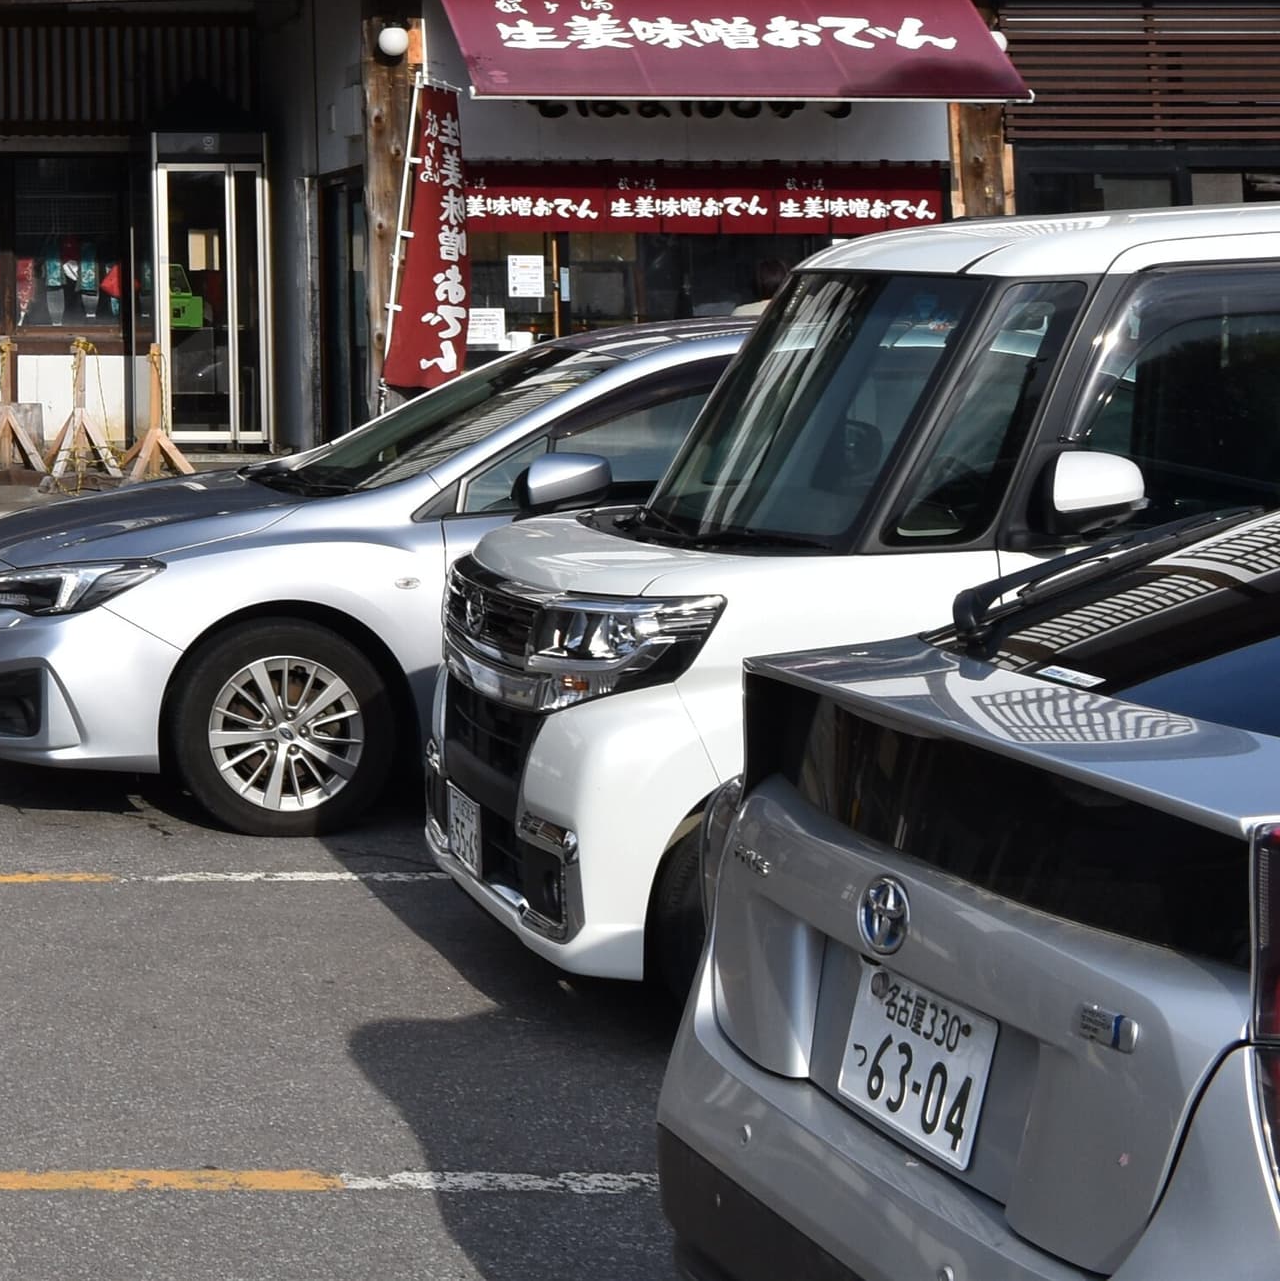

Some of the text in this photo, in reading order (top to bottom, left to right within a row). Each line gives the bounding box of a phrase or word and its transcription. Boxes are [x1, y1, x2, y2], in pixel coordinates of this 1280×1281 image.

[496, 13, 958, 50] 生姜味噌おでん
[465, 195, 599, 220] 姜味噌おでん
[610, 195, 768, 219] 生姜味噌おでん
[779, 196, 937, 221] 生姜味噌おでん
[867, 1033, 973, 1152] 63-04
